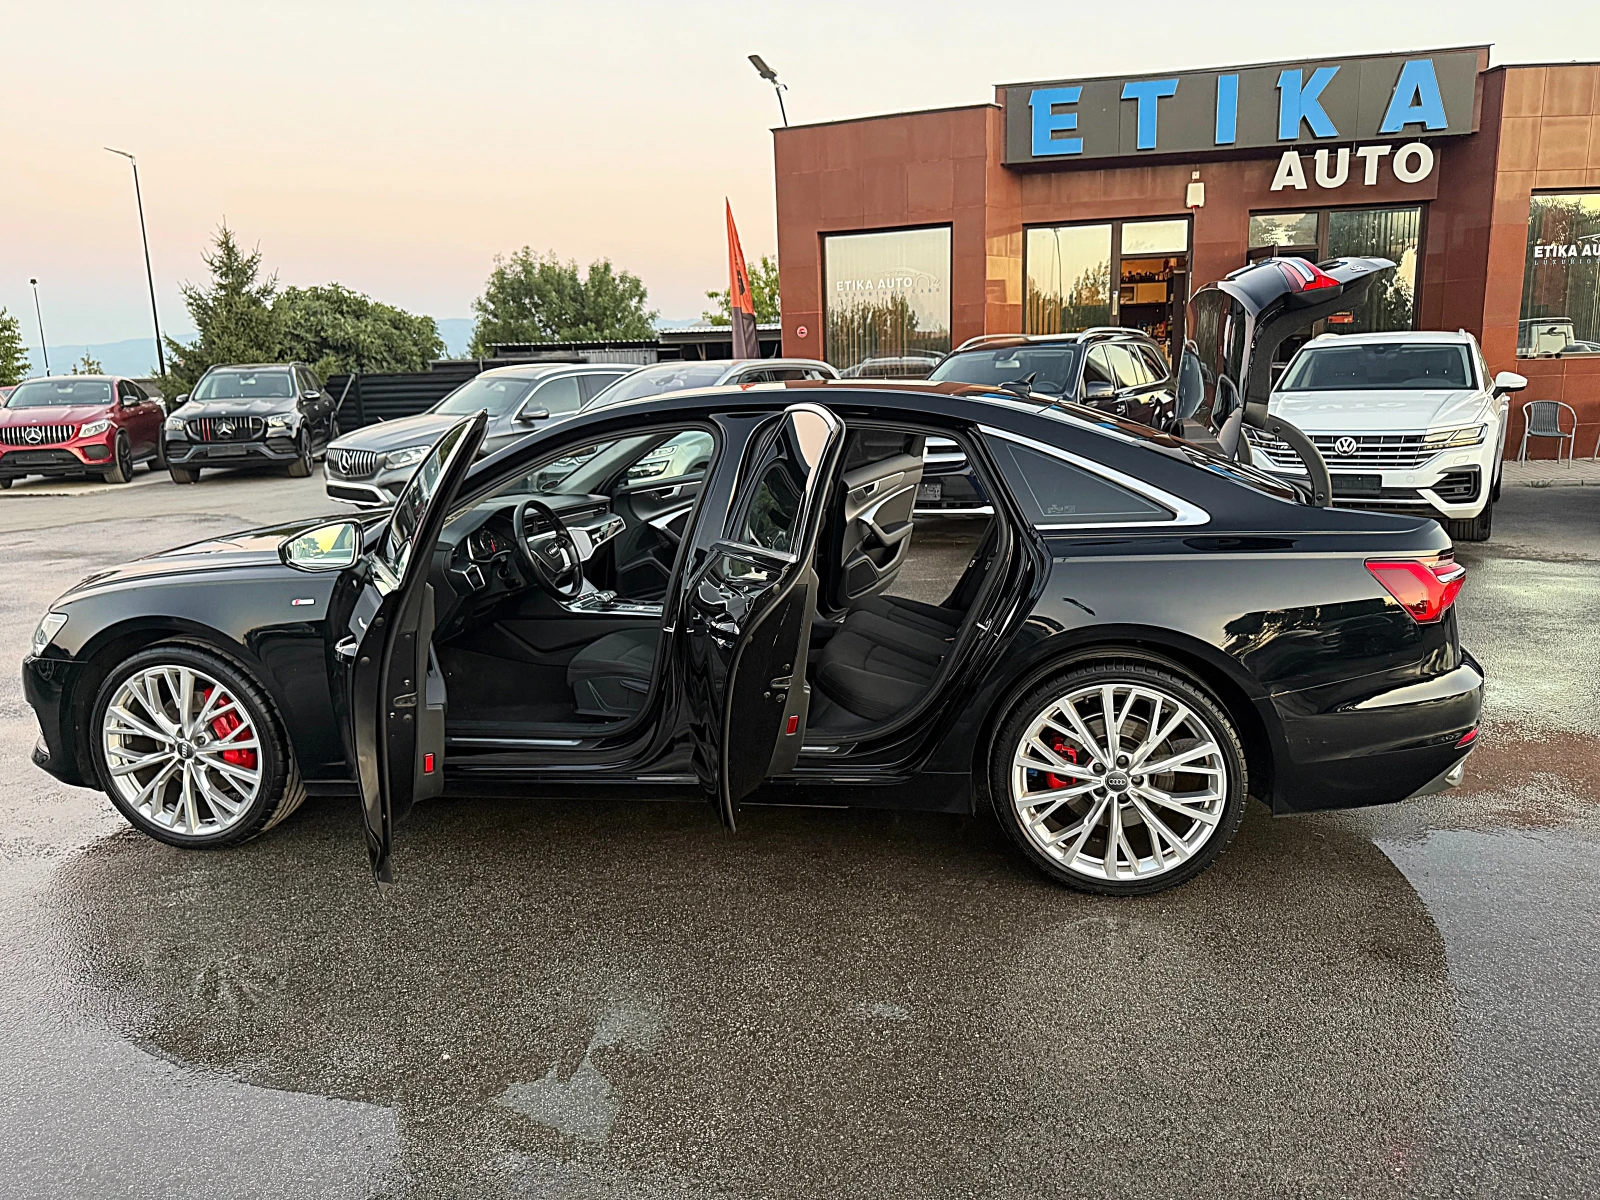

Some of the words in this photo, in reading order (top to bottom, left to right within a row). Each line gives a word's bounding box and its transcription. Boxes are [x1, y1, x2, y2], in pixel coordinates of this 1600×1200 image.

[1028, 58, 1448, 156] ETIKA
[1270, 142, 1434, 191] AUTO
[1534, 245, 1578, 258] ETIKA
[836, 280, 874, 291] ETIKA
[877, 277, 913, 289] AUTO
